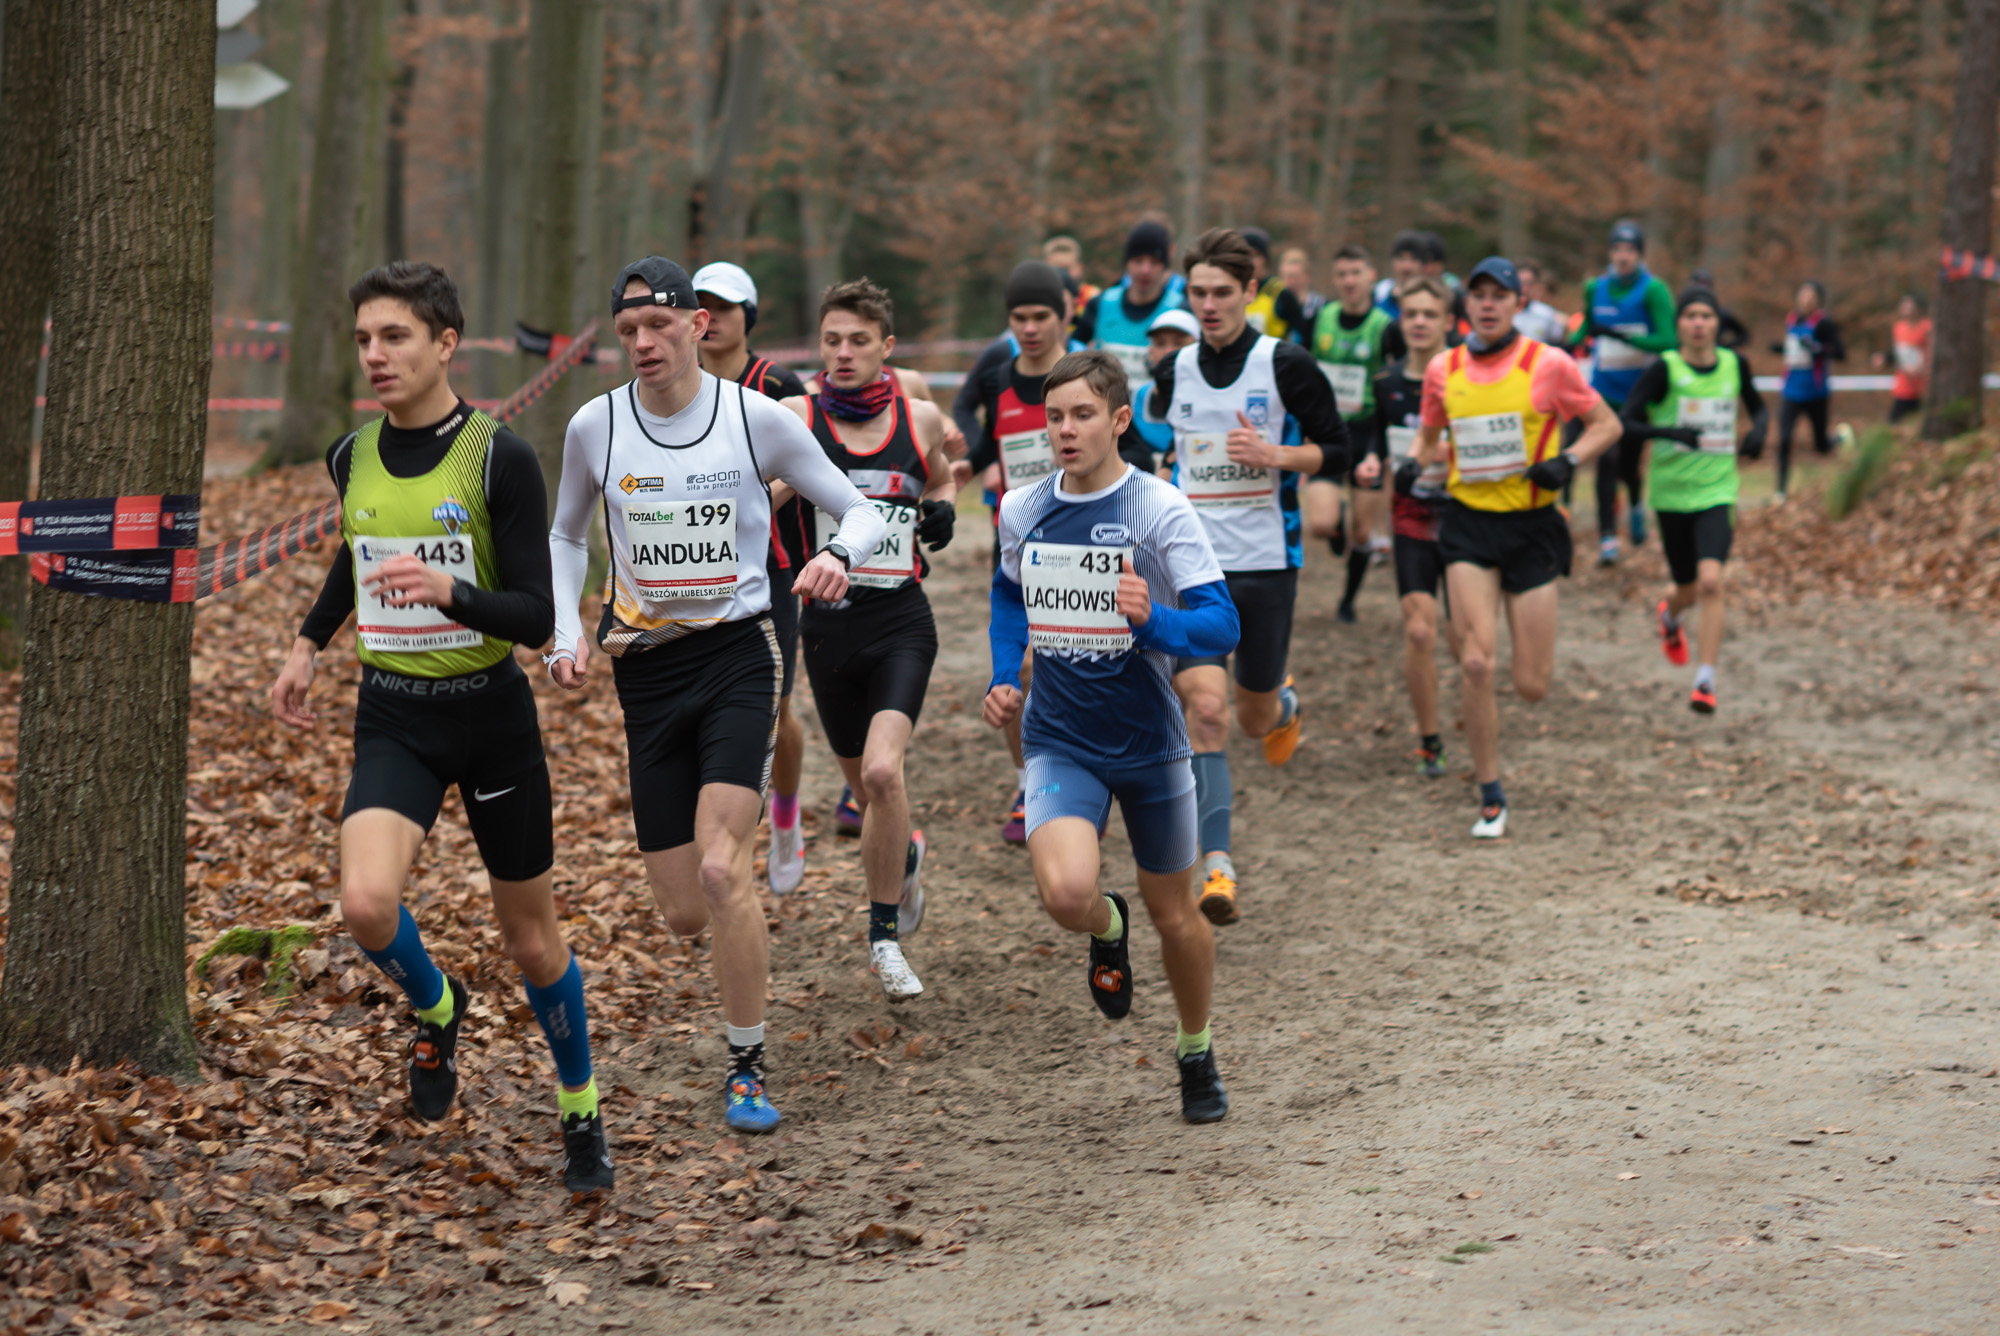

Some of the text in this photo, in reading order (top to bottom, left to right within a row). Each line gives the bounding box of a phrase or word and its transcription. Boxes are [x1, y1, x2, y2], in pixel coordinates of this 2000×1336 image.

[1488, 416, 1518, 434] 155
[639, 478, 663, 487] OPTIMA
[712, 480, 741, 490] precyzji
[628, 510, 674, 522] TOTALbet
[684, 503, 731, 527] 199
[414, 541, 466, 566] 443
[632, 541, 733, 566] JANDUŁA
[1080, 552, 1125, 574] 431
[639, 585, 734, 598] OMASZÓW LUBELSKI 2021
[412, 635, 453, 648] LUBELSKI
[456, 632, 478, 644] 2021
[1031, 633, 1129, 646] OMASZÓW LUBELSKI 2021
[370, 670, 490, 697] NIKE PRO
